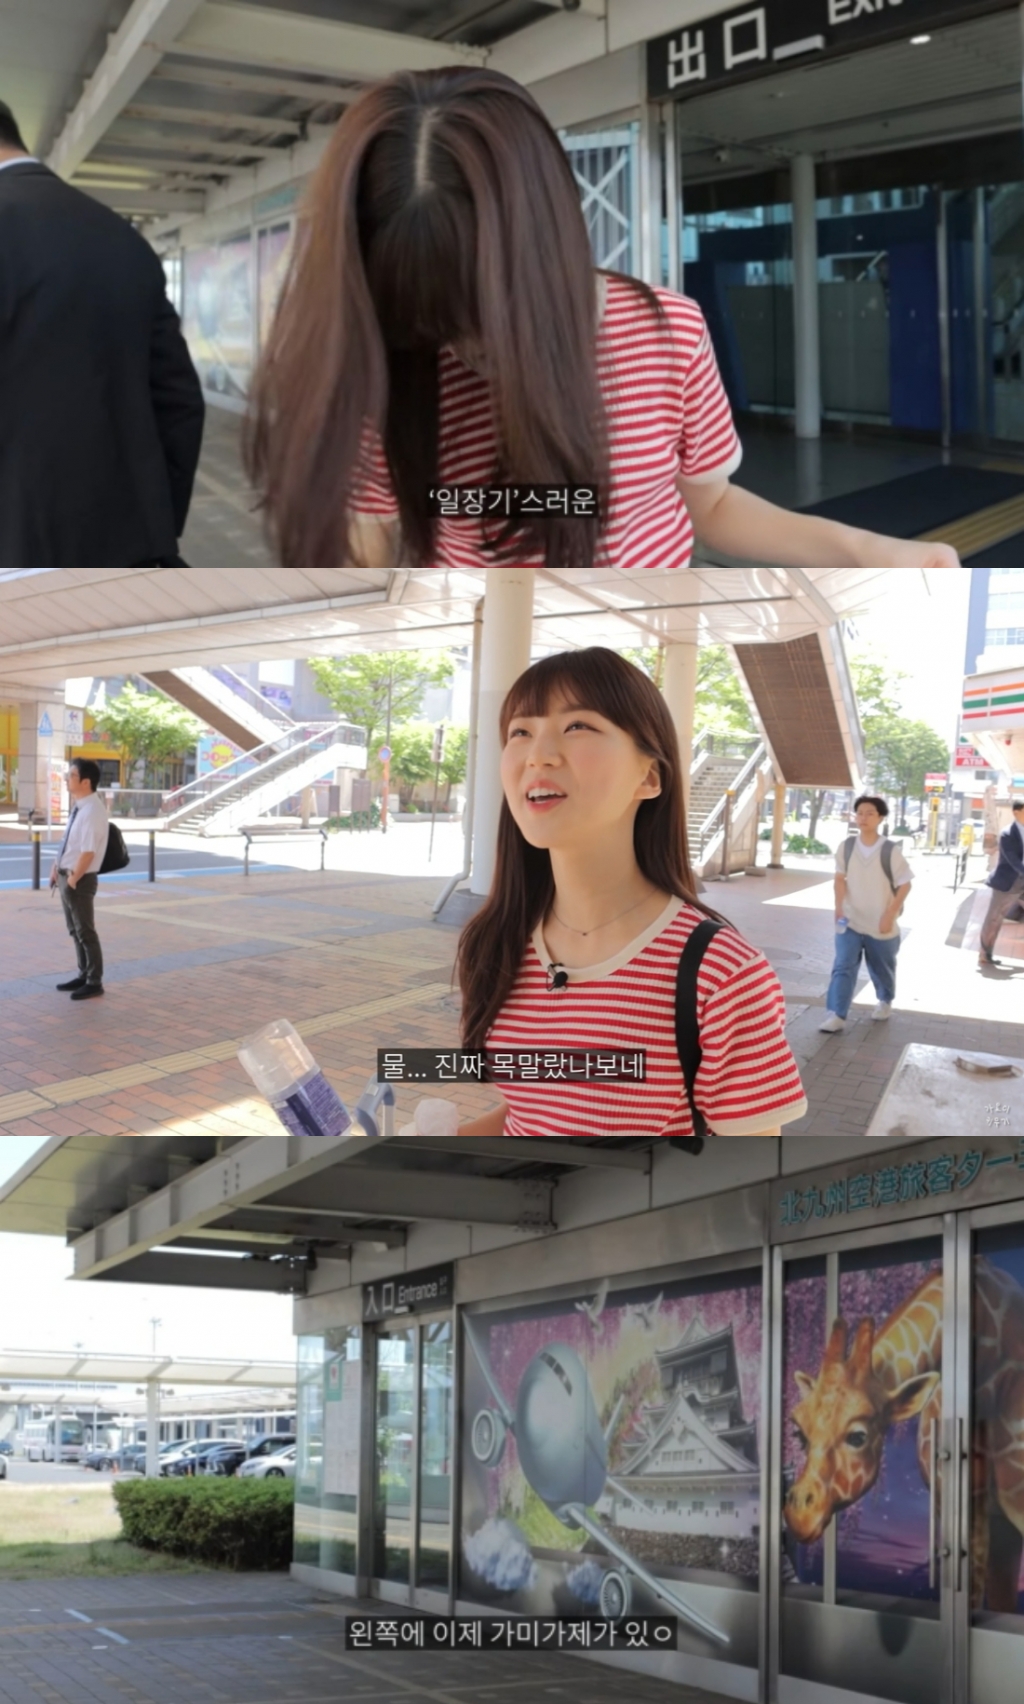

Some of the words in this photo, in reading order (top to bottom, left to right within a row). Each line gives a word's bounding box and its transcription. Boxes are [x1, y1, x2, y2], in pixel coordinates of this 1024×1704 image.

[667, 8, 767, 88] 出口
[961, 758, 985, 767] ATM
[779, 1138, 1024, 1226] 北九州空港旅客ター
[365, 1282, 395, 1316] 入口
[398, 1282, 438, 1304] Entrance
